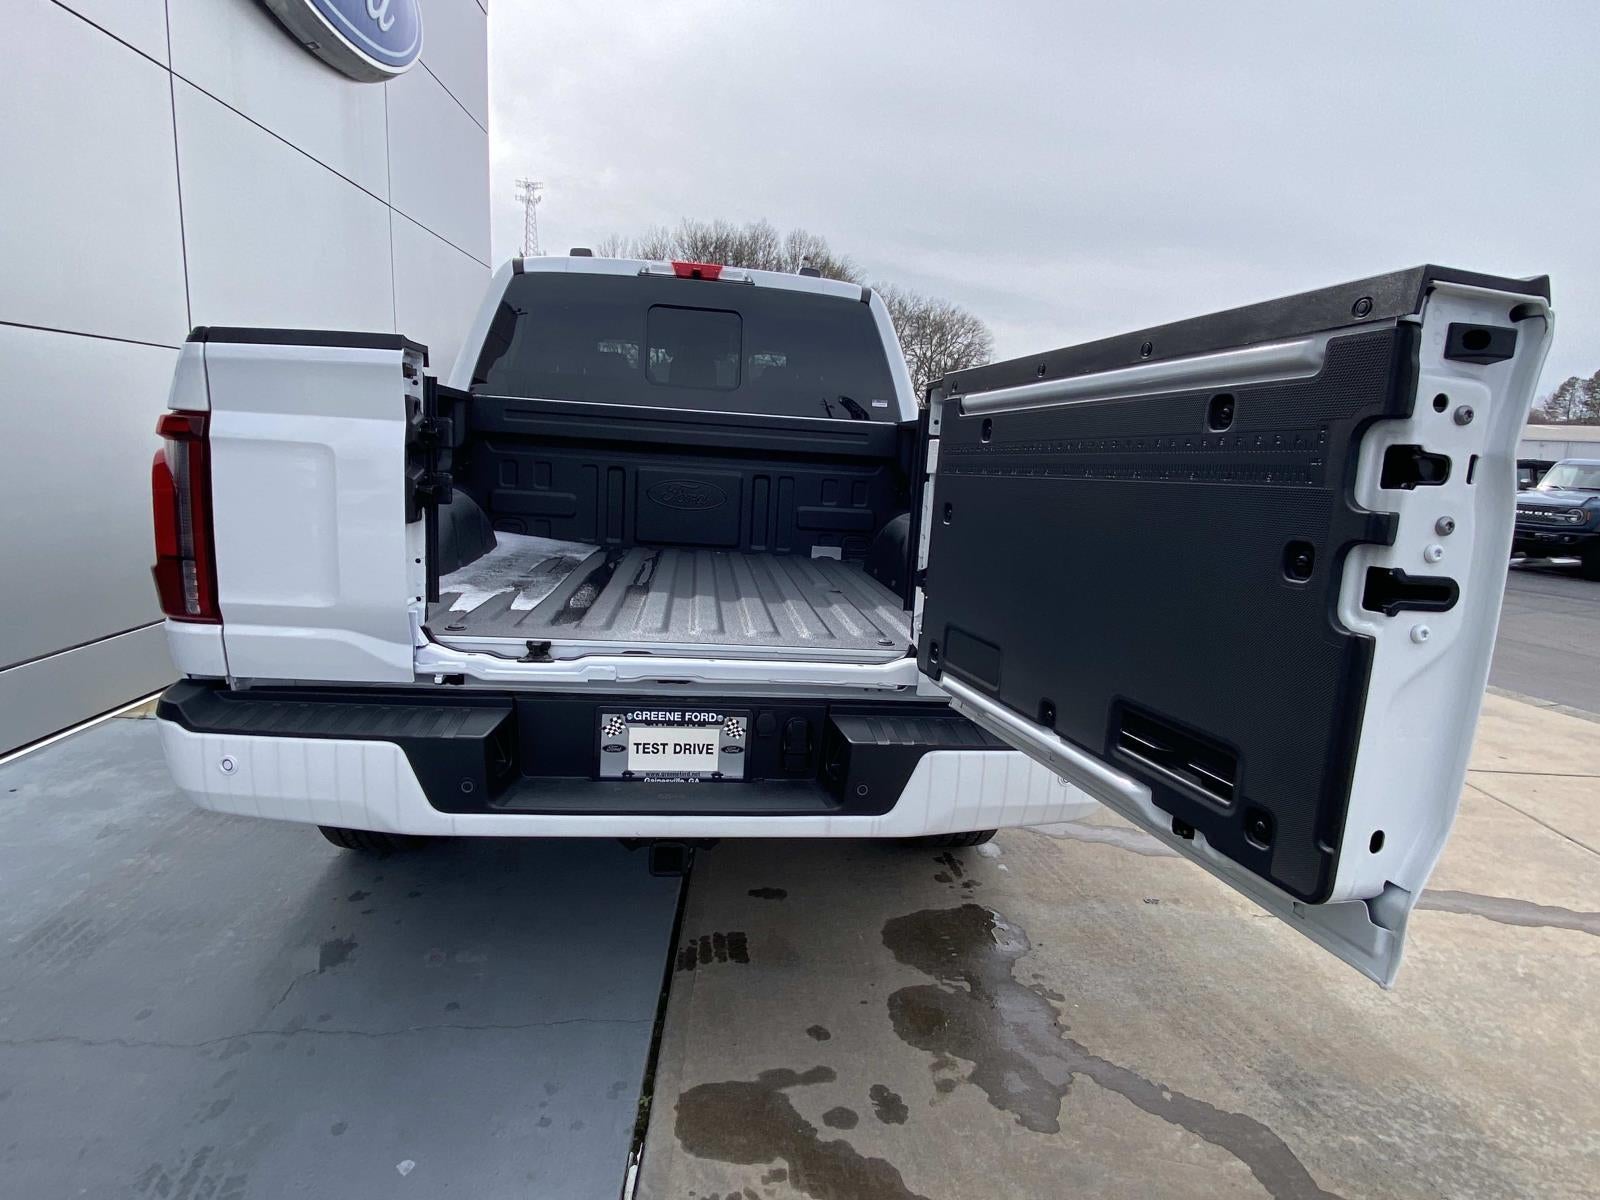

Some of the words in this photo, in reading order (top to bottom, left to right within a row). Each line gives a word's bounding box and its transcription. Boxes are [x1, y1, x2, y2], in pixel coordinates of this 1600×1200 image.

[633, 711, 682, 722] GREENE
[685, 711, 717, 723] FORD
[633, 742, 669, 755] TEST
[673, 743, 714, 755] DRIVE
